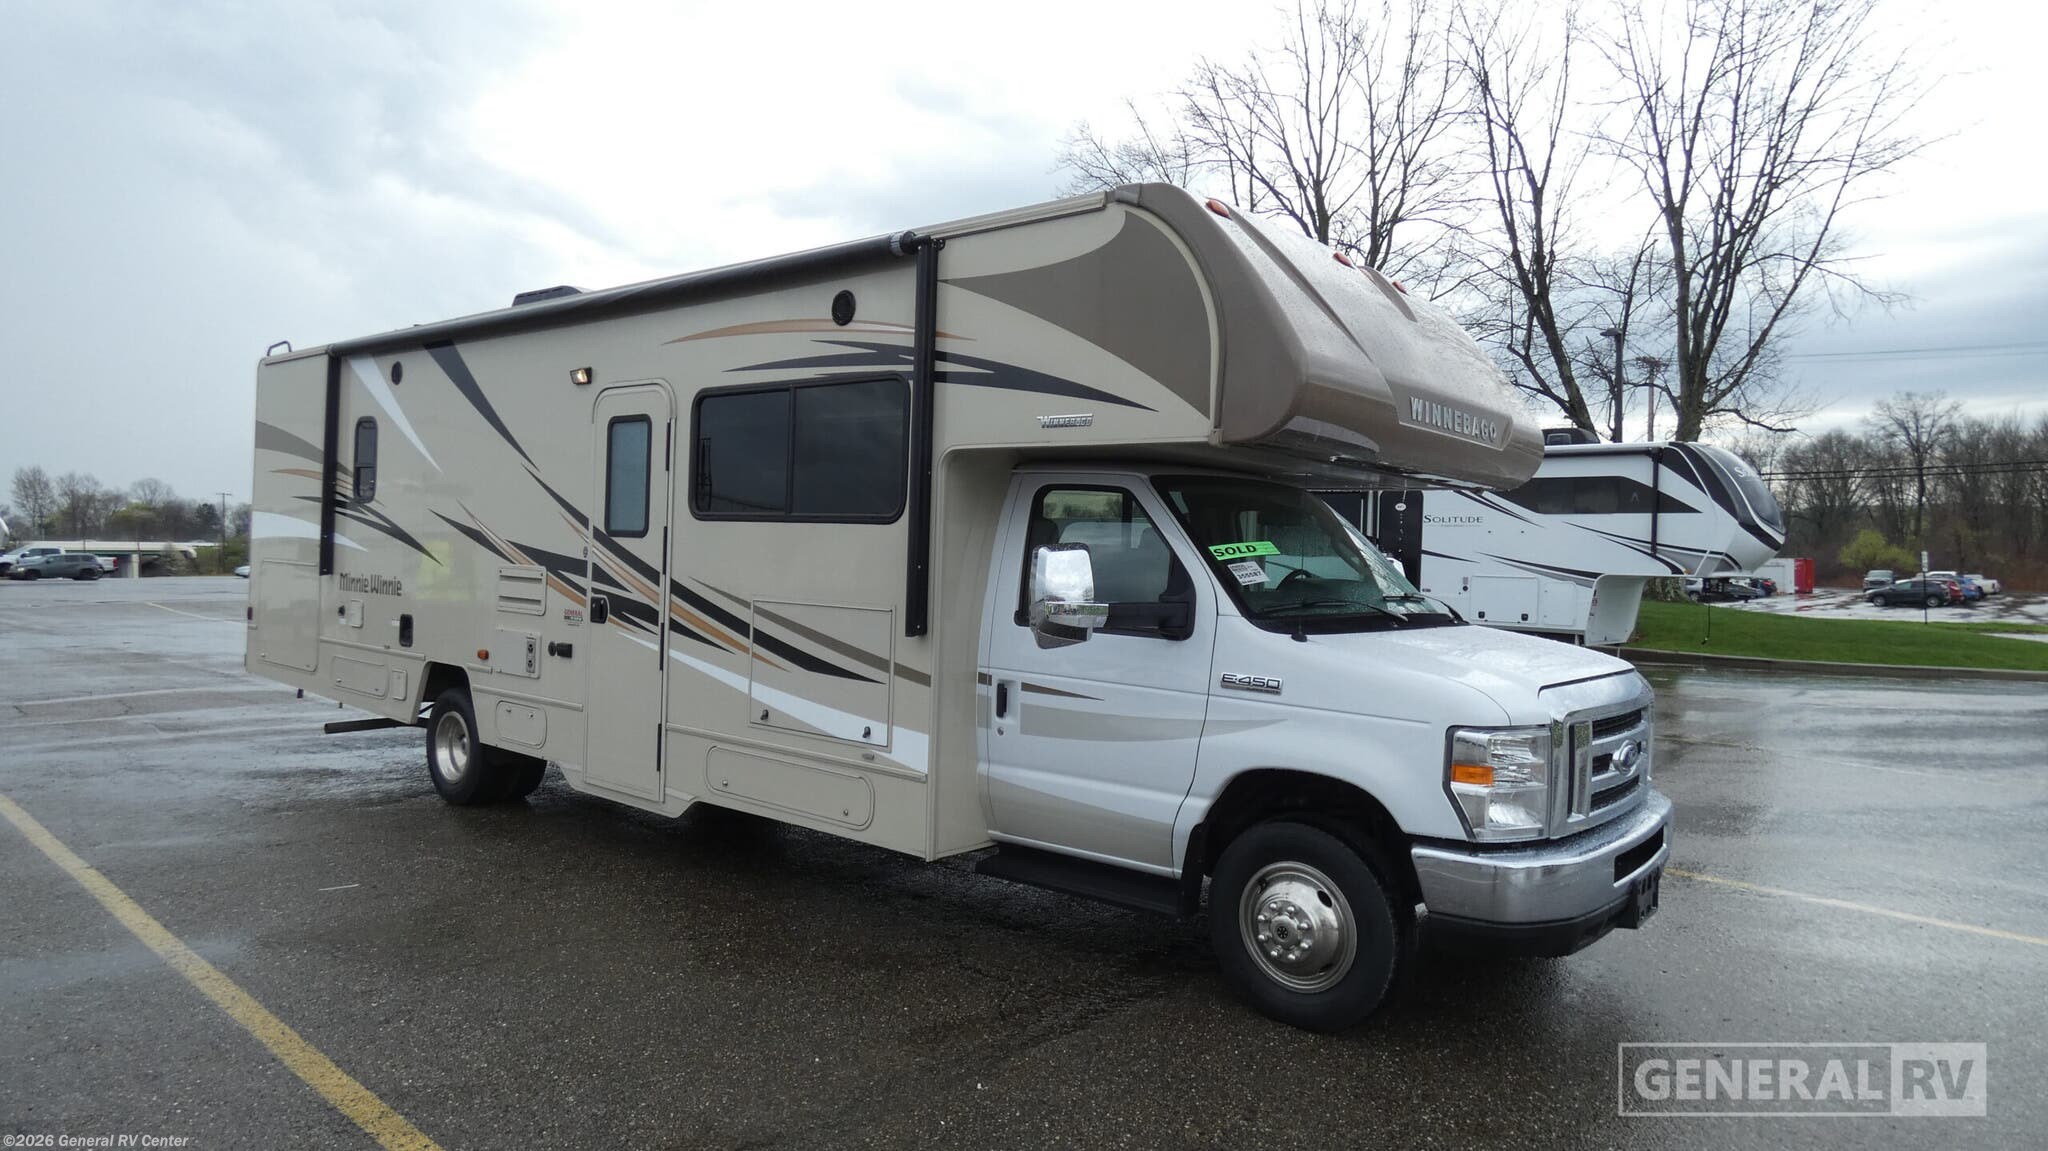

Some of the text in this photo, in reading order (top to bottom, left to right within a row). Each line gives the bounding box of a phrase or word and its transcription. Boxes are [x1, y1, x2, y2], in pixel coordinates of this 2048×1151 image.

[1409, 396, 1497, 442] WINNEBAGO
[1214, 545, 1256, 557] SOLD
[340, 573, 402, 596] Minnie Winnie
